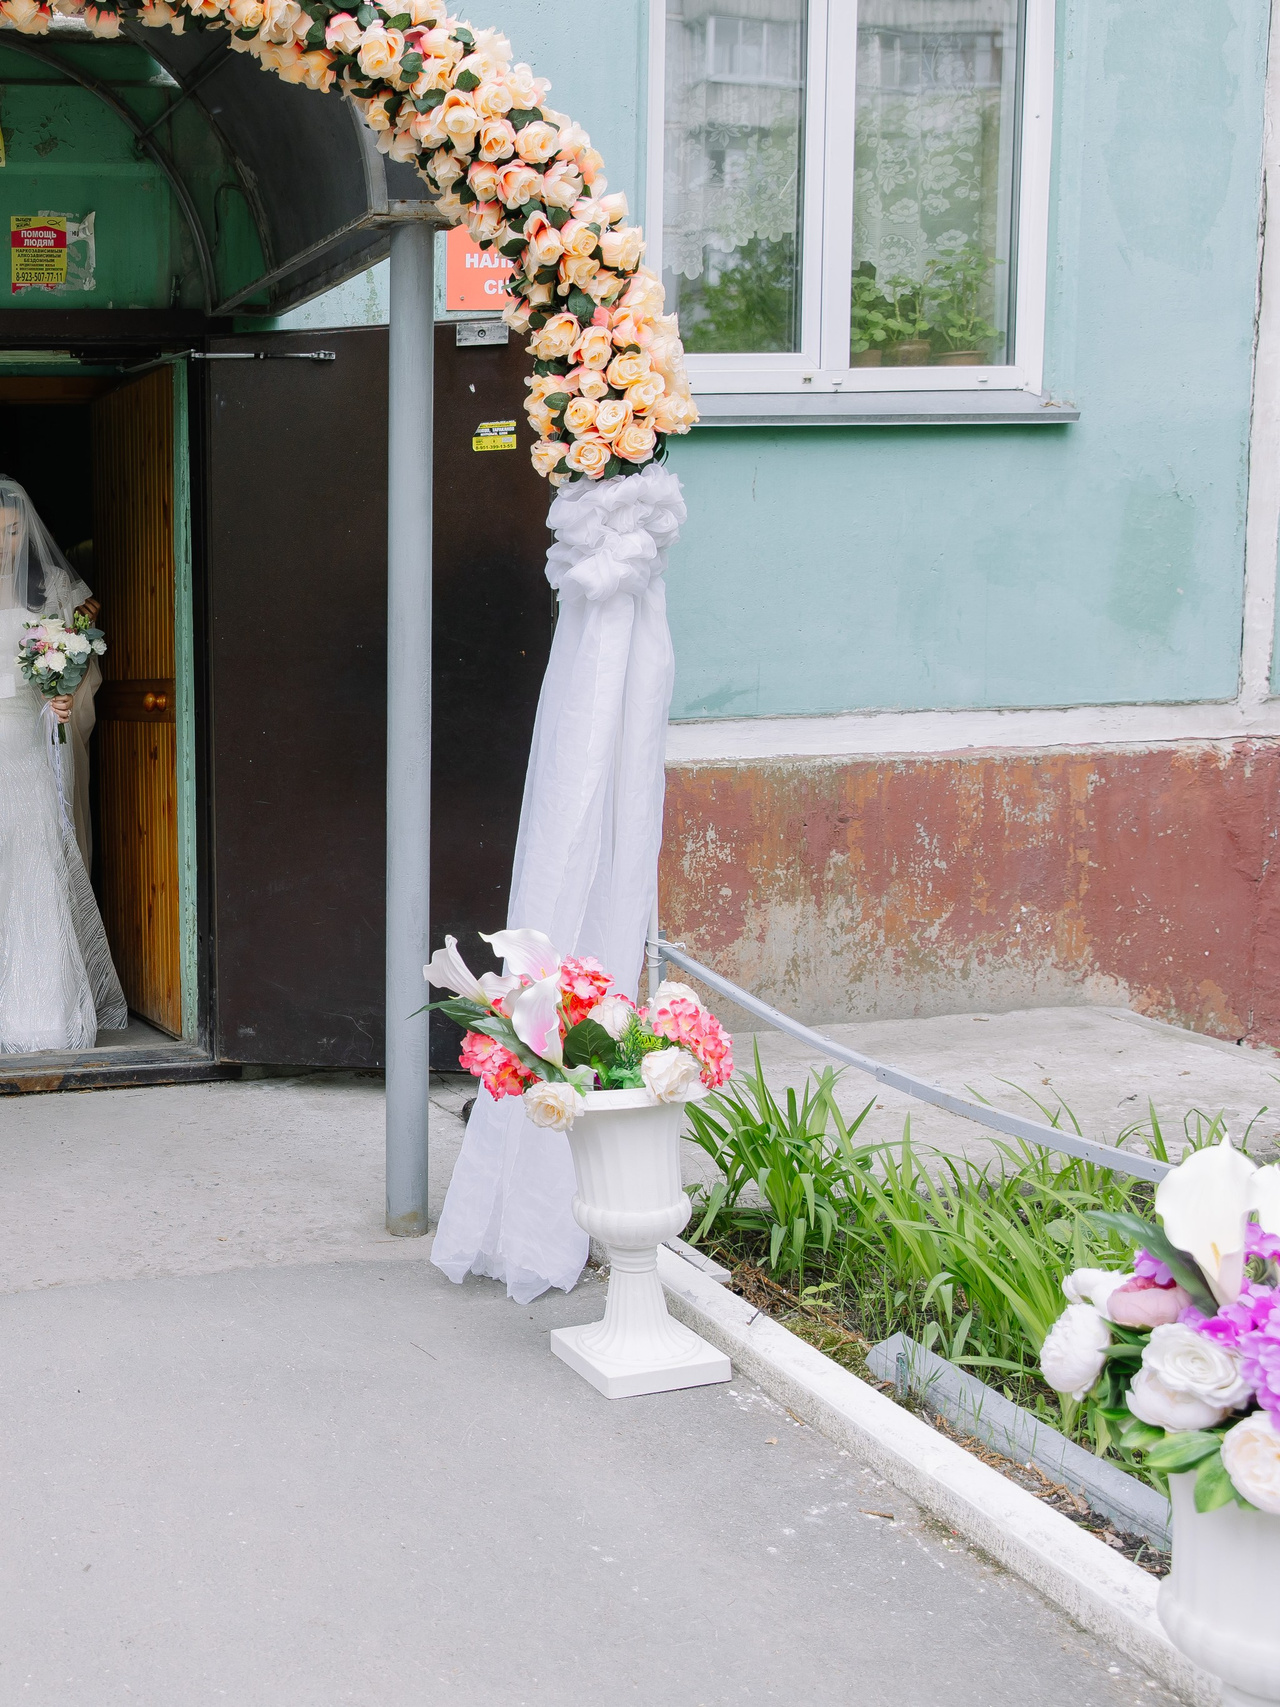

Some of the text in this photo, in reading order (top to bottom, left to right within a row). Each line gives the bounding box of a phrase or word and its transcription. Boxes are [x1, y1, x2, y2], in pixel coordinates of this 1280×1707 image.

[21, 230, 57, 239] ПОМОЩЬ
[23, 239, 54, 247] ЛЮДЯМ
[15, 272, 63, 281] 8-923-507-77-11
